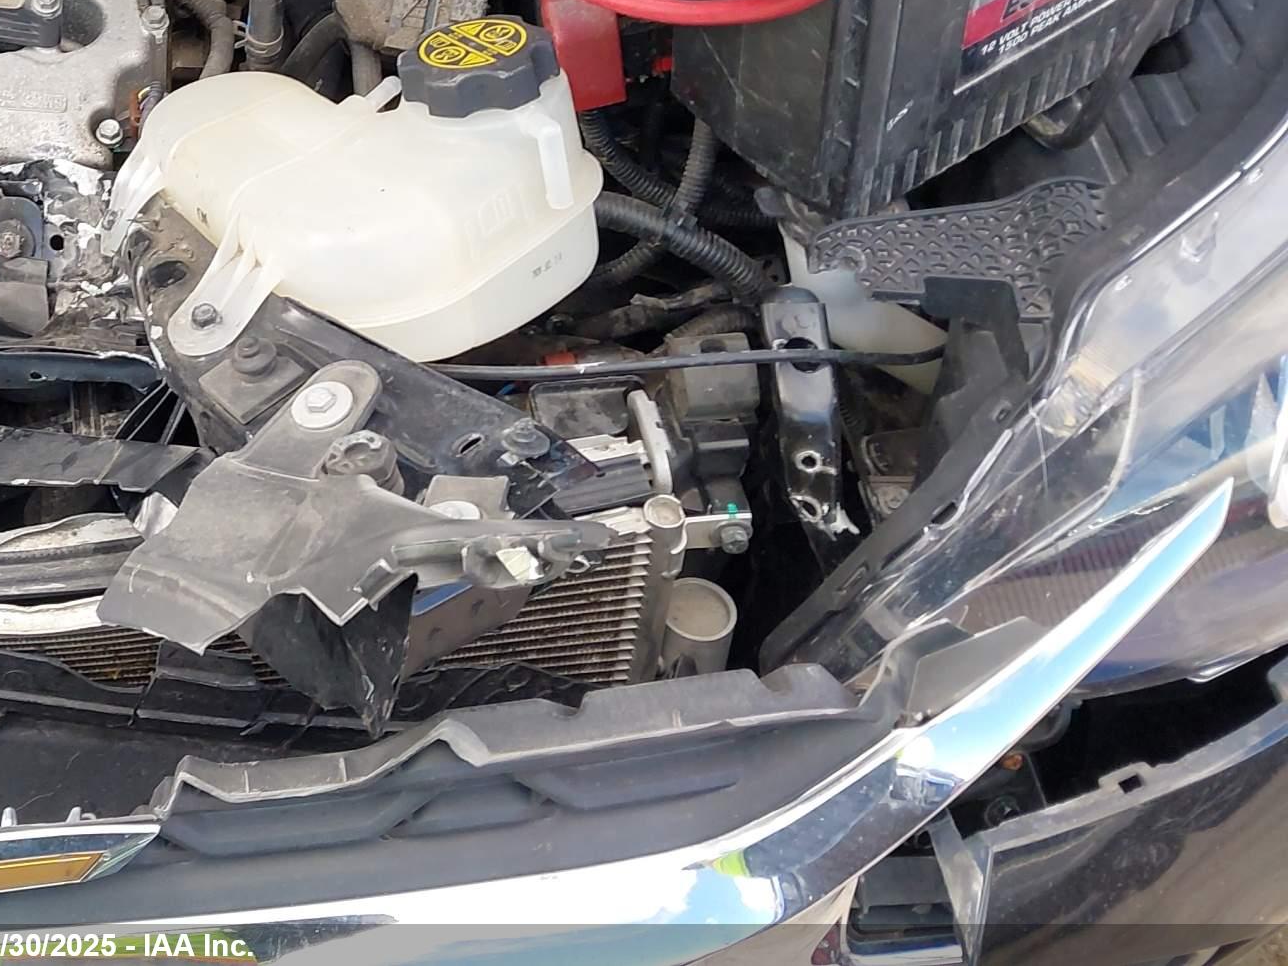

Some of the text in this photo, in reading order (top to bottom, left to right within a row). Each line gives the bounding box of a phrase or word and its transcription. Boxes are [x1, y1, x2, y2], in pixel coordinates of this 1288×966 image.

[981, 39, 998, 56] 12
[998, 21, 1029, 45] VOLT
[1029, 0, 1074, 29] POWER
[998, 32, 1029, 55] 1500
[1029, 13, 1060, 37] PEAK
